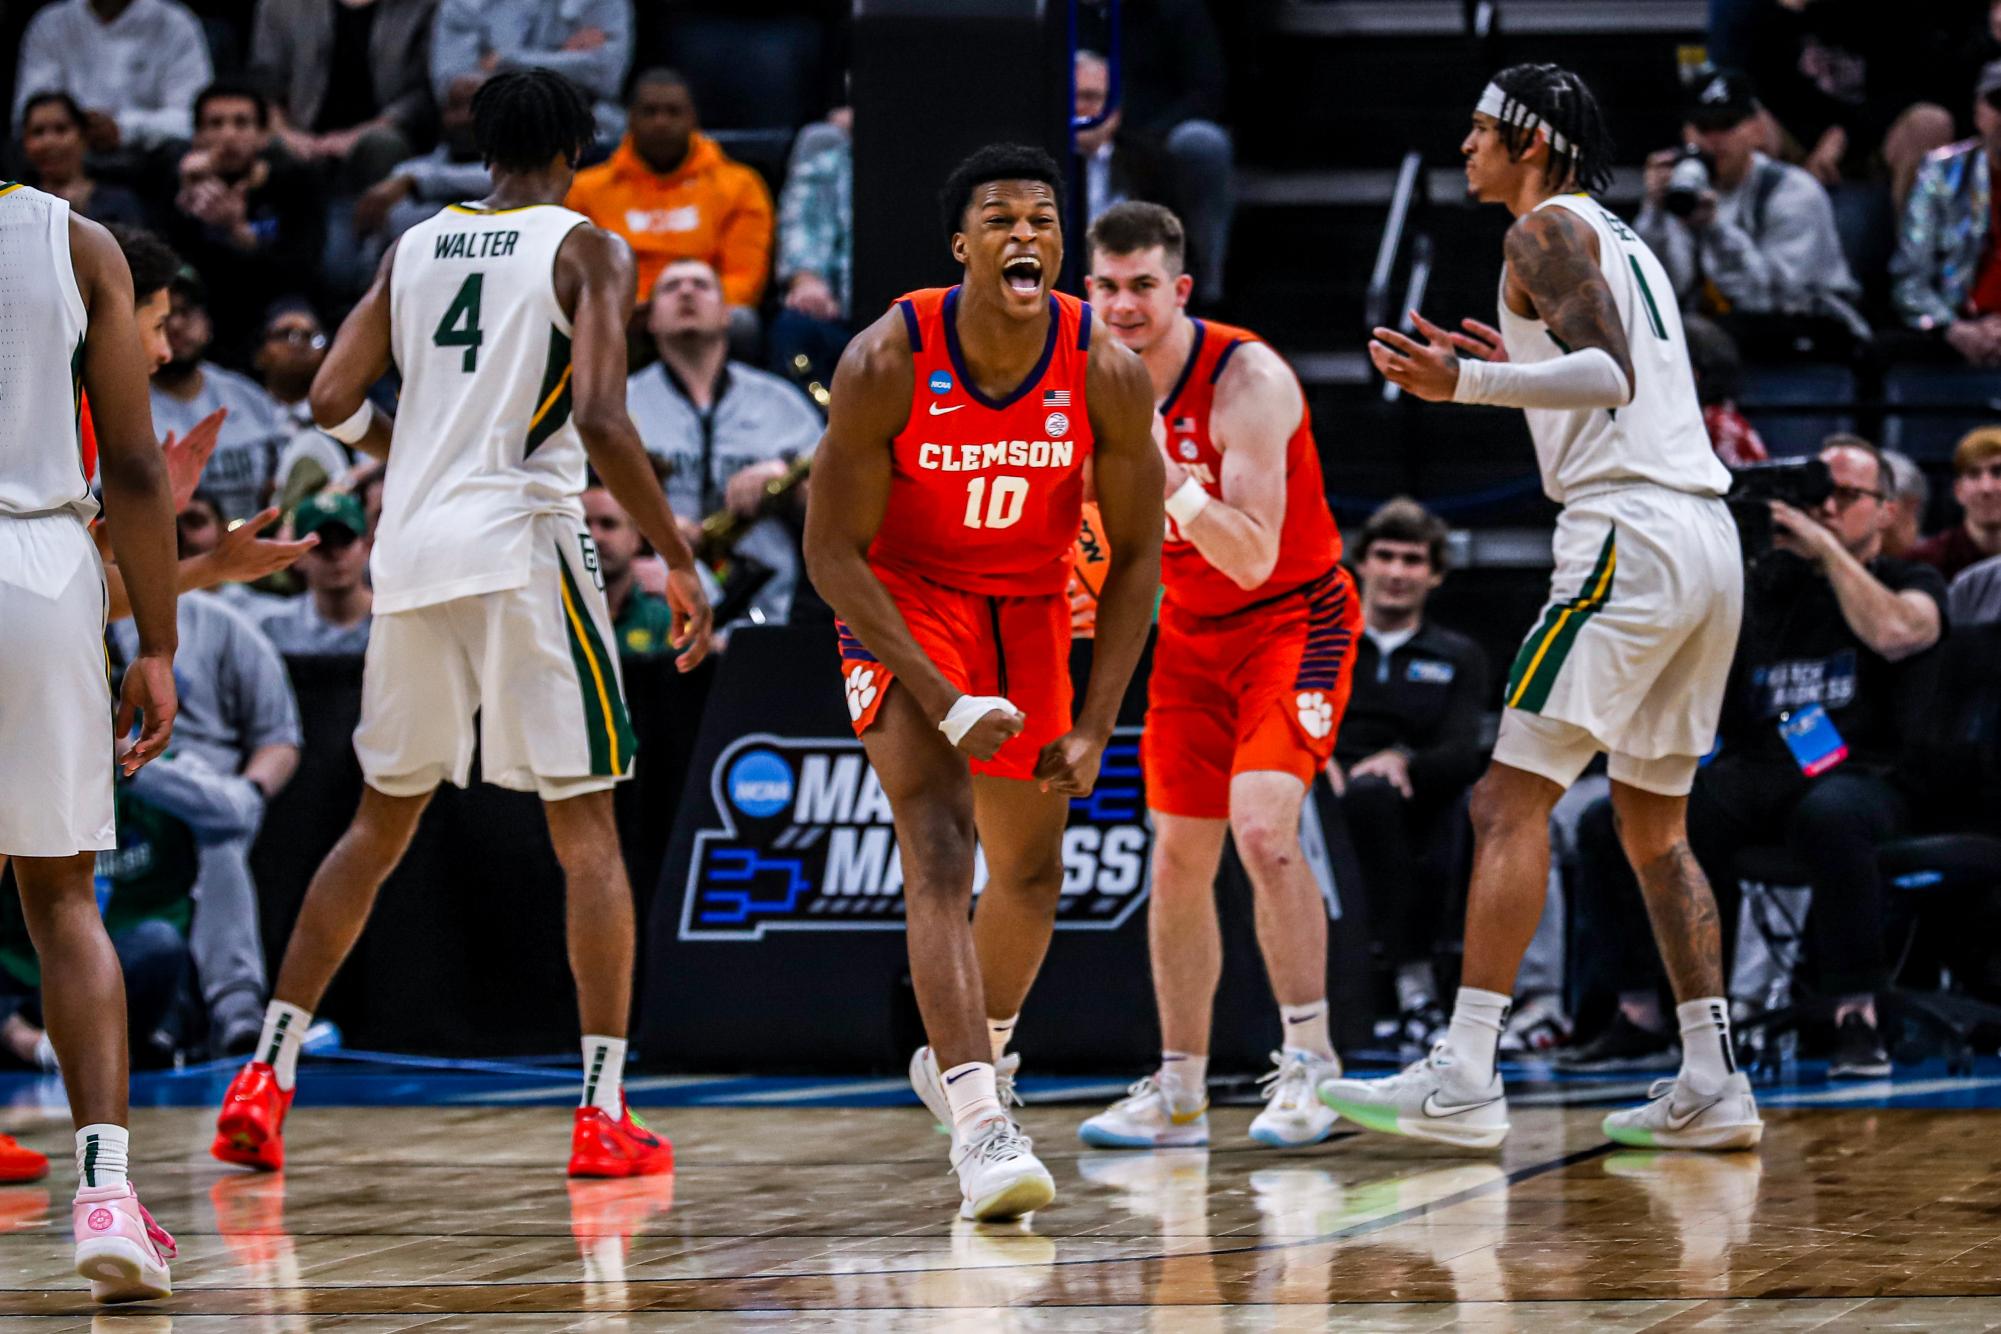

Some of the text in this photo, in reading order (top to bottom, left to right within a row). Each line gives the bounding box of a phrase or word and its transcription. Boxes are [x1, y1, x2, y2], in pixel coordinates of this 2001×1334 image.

[434, 230, 520, 259] WALTER
[432, 272, 484, 373] 4
[918, 440, 1074, 472] CLEMSON
[963, 475, 1030, 529] 10
